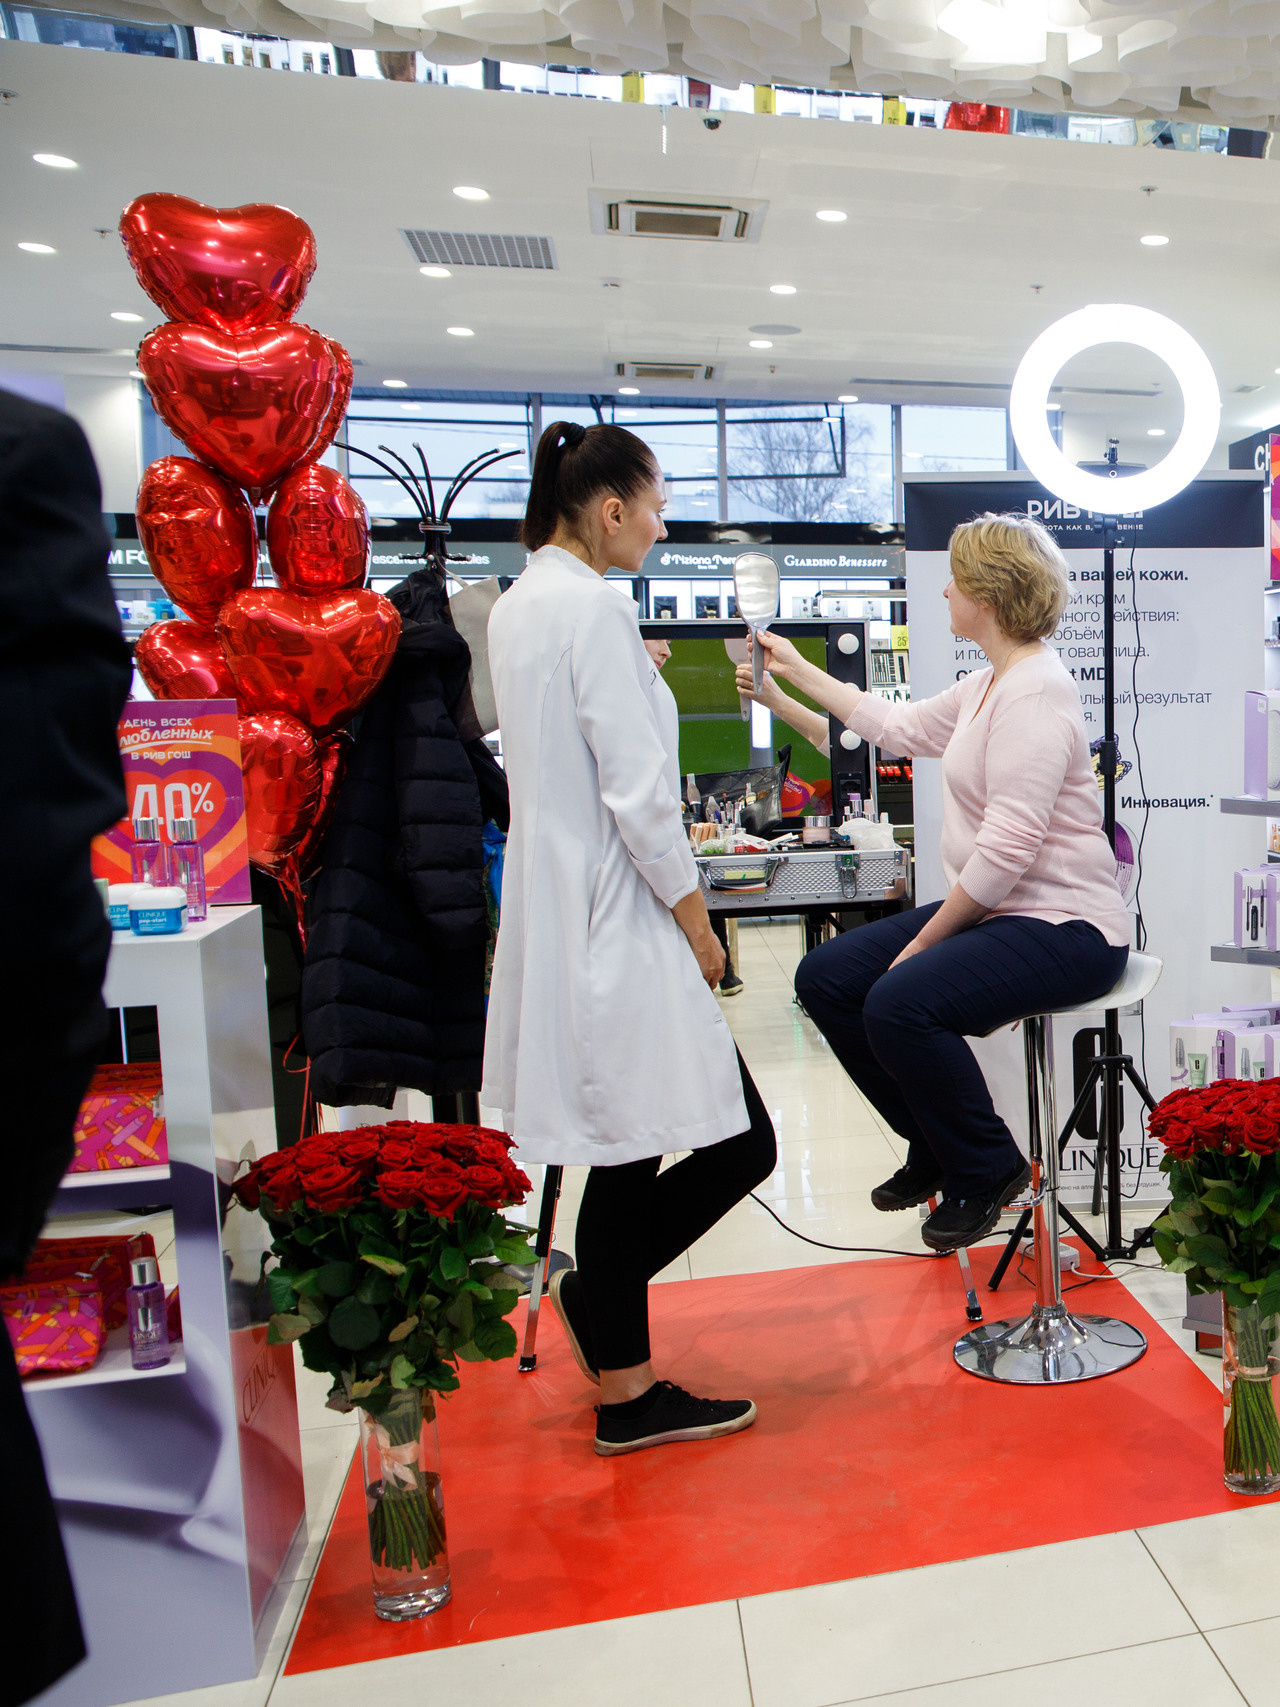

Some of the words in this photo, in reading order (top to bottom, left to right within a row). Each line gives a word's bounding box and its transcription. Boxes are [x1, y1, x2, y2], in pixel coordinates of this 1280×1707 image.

[838, 555, 888, 567] Benessere
[1080, 567, 1135, 581] ваей
[1139, 570, 1188, 581] кожи.
[1086, 594, 1126, 607] крм
[1113, 608, 1180, 622] ействия:
[1136, 692, 1213, 707] результат
[124, 718, 156, 727] ДЕНЬ
[161, 717, 193, 727] ВСЕХ
[119, 728, 214, 748] любленных
[143, 752, 165, 760] РИВ
[167, 751, 192, 760] ГОШ
